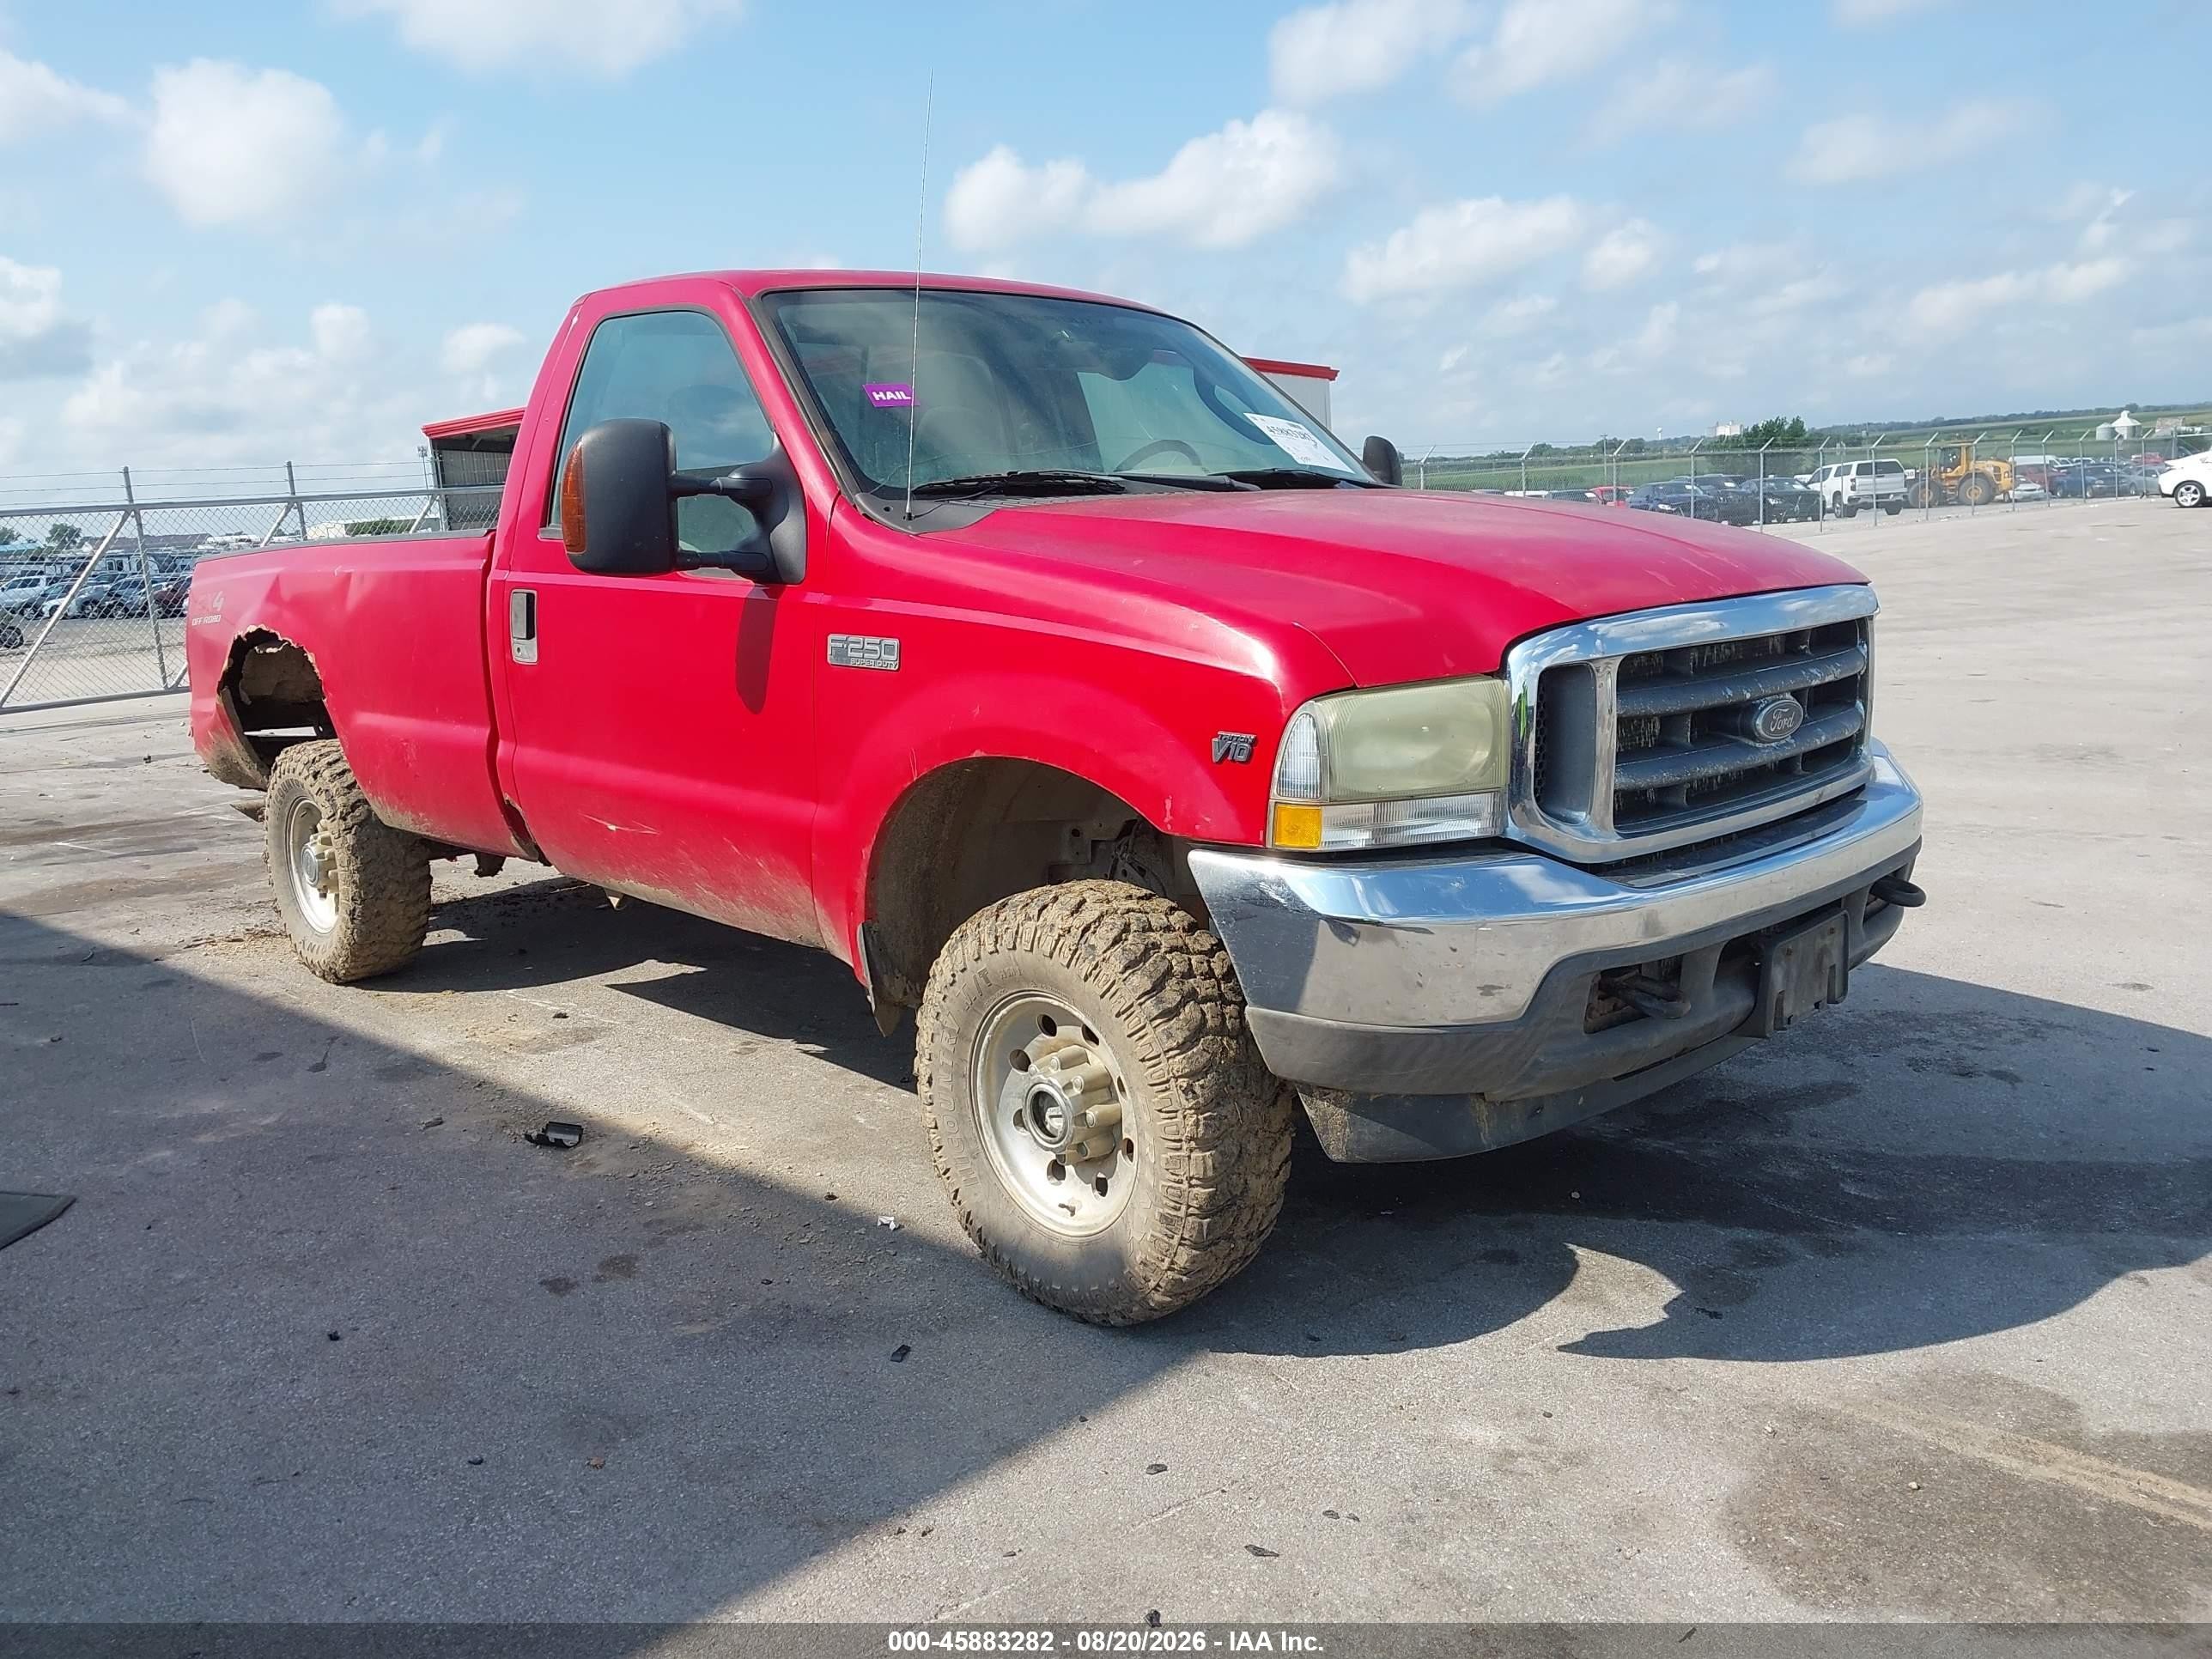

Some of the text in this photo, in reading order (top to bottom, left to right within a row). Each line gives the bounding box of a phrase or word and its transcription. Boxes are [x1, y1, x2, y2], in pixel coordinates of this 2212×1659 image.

[872, 391, 911, 401] HAIL
[851, 658, 898, 670] SUPER DUTY
[1770, 708, 1796, 732] Ford
[1218, 732, 1257, 744] TRITON
[1212, 738, 1252, 763] V10
